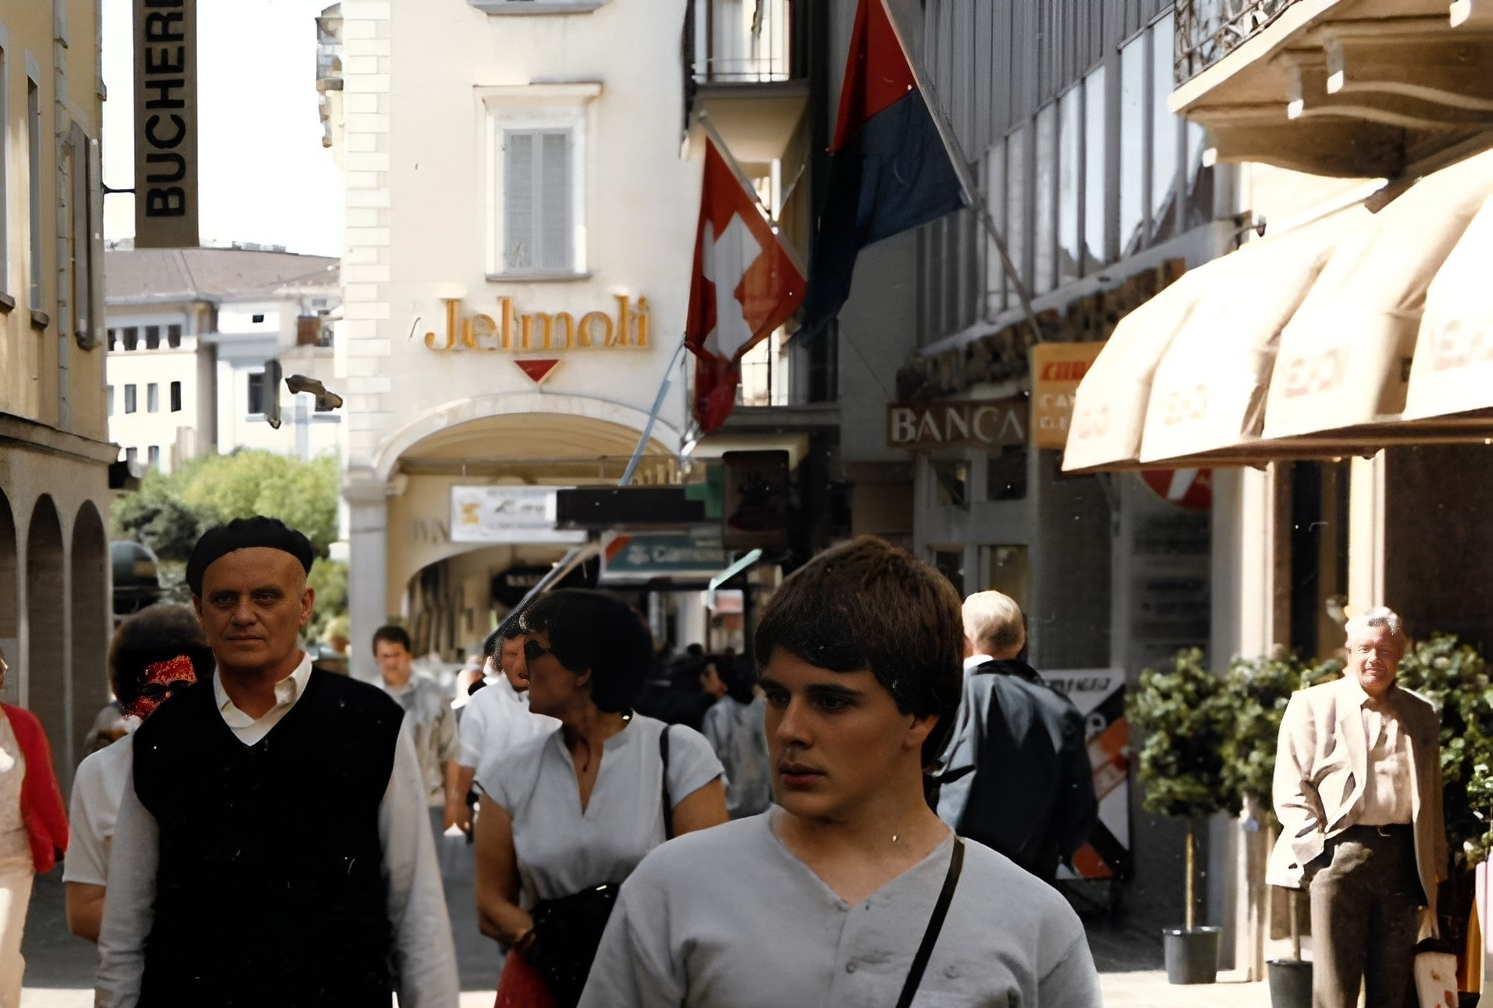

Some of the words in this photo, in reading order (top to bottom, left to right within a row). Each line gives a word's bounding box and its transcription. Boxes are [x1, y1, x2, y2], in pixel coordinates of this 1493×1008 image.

[145, 0, 186, 217] BUCHER
[424, 294, 650, 351] Jelmoli
[891, 406, 1024, 442] BANCA
